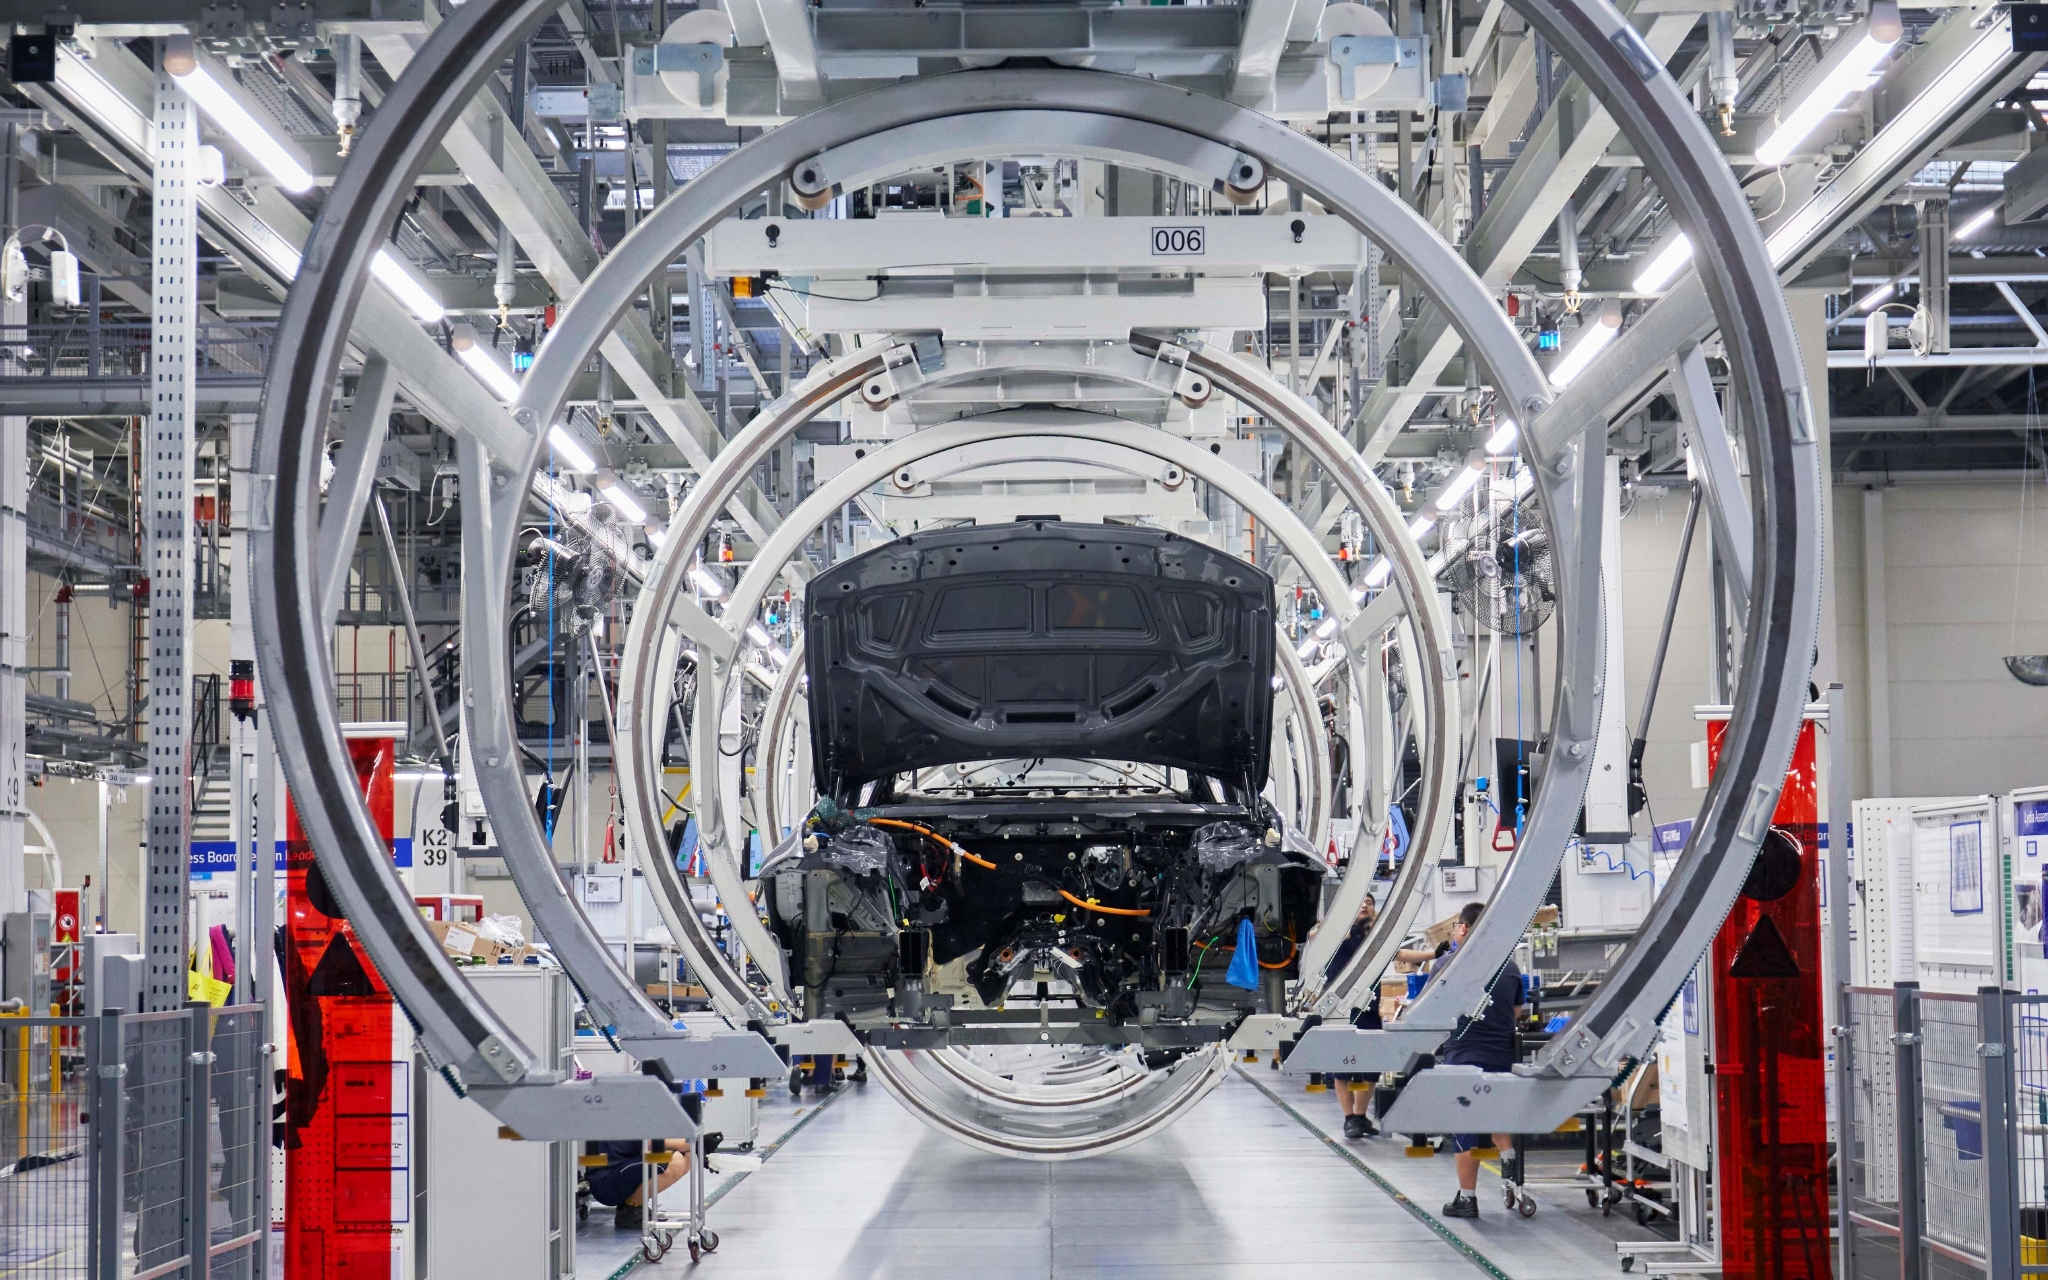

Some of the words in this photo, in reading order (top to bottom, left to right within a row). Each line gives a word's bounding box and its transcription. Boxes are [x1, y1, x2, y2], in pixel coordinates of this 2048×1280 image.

[1155, 230, 1201, 251] 006
[381, 455, 391, 467] 01
[423, 829, 447, 846] K2
[424, 849, 447, 866] 39
